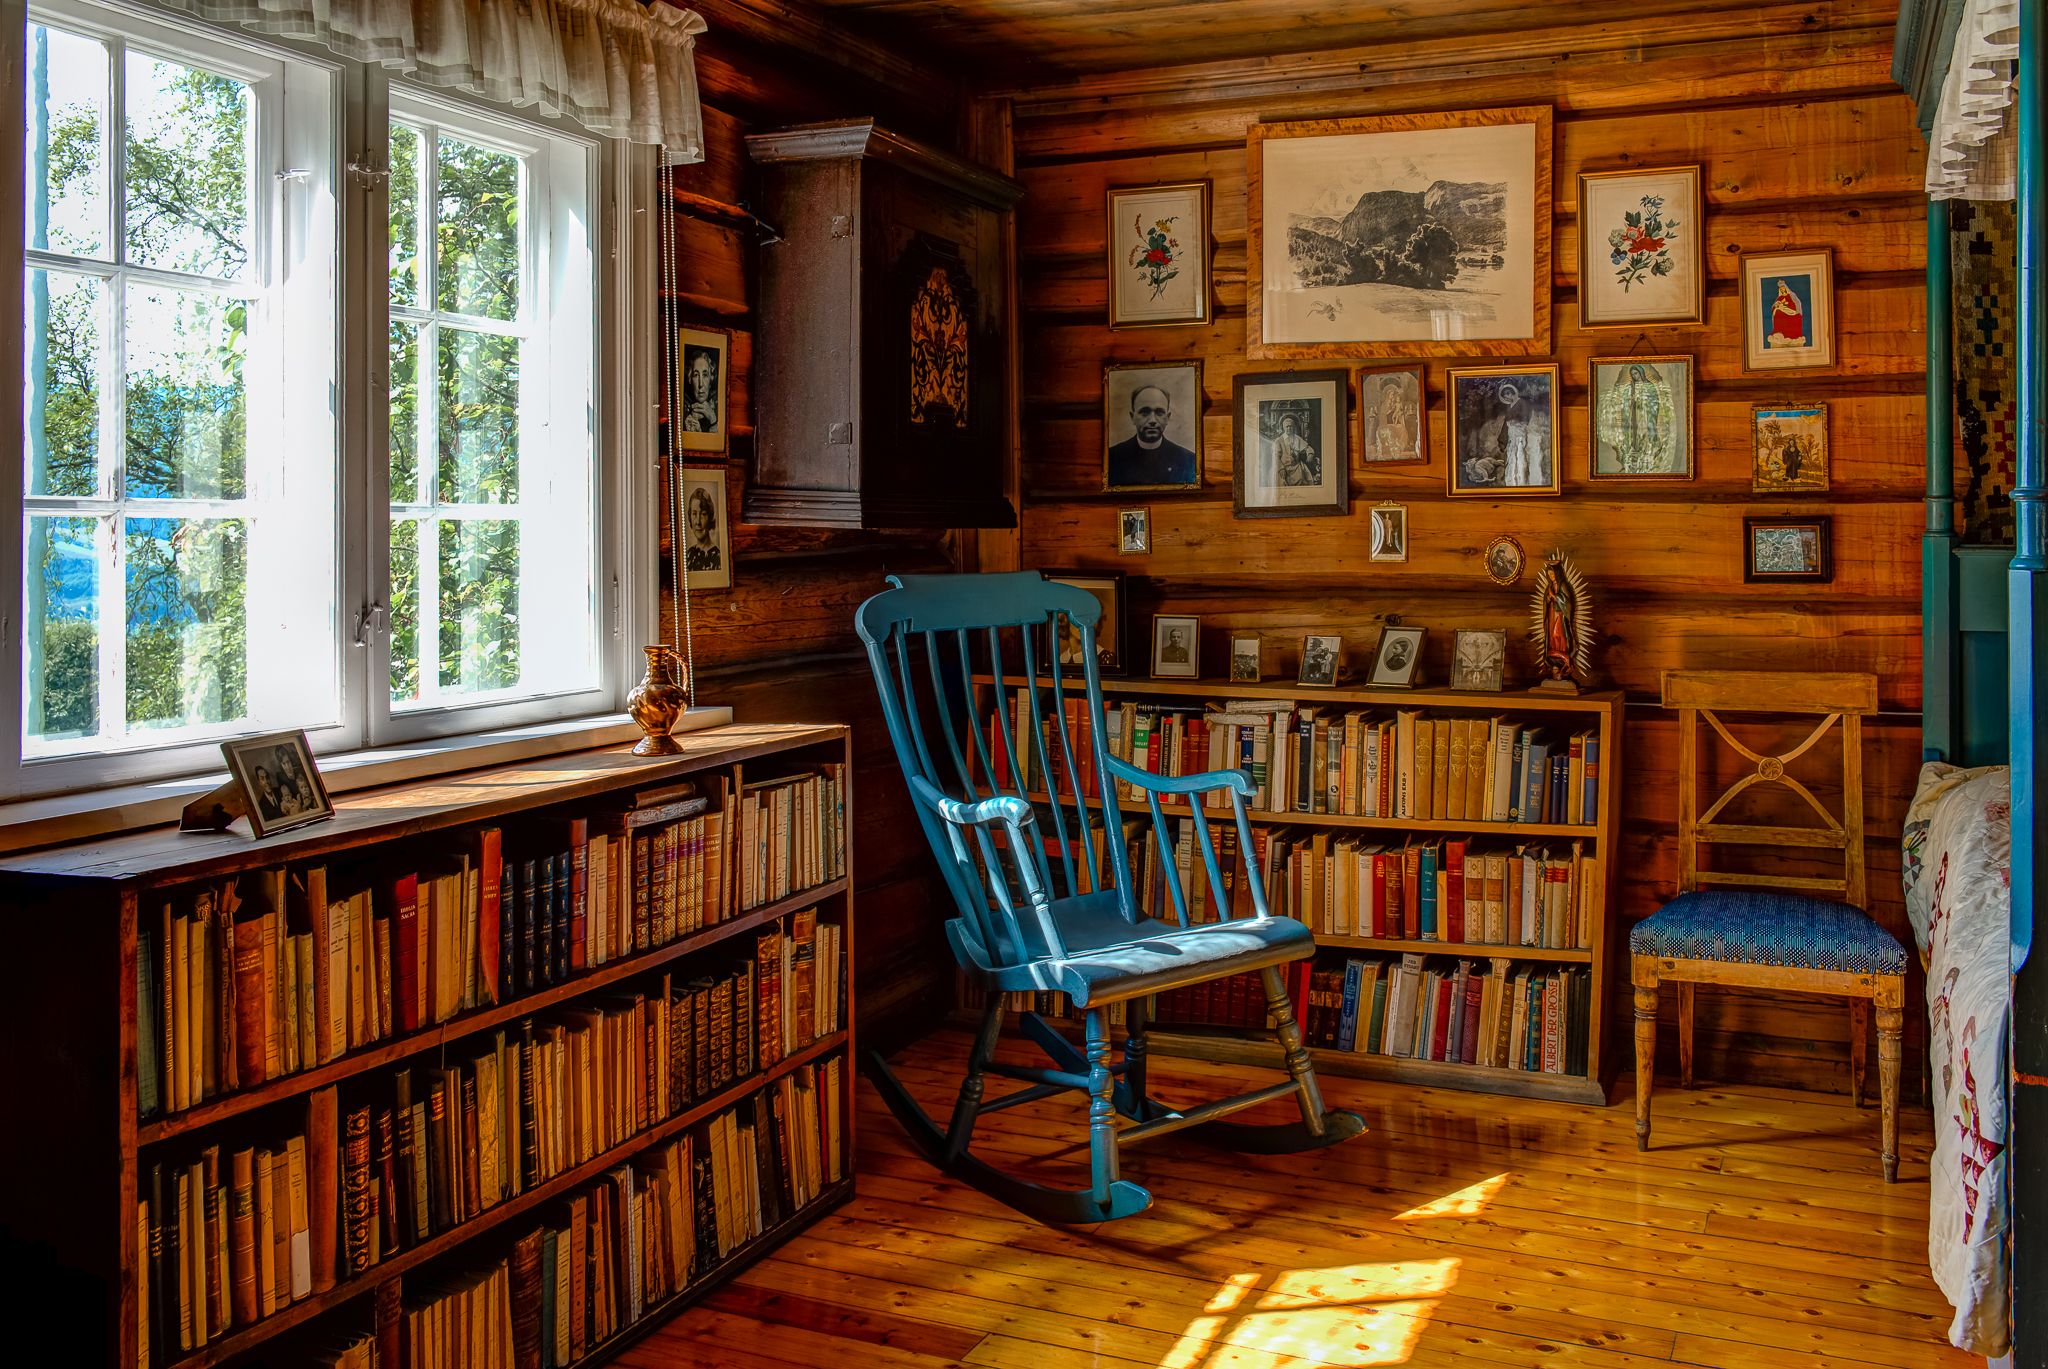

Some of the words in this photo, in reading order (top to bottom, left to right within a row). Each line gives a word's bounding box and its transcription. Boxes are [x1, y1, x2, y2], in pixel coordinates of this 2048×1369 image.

[401, 911, 416, 920] SACRA
[1548, 981, 1558, 1018] GROSSE
[1548, 1020, 1557, 1037] DER
[1546, 1038, 1557, 1072] ALBERT
